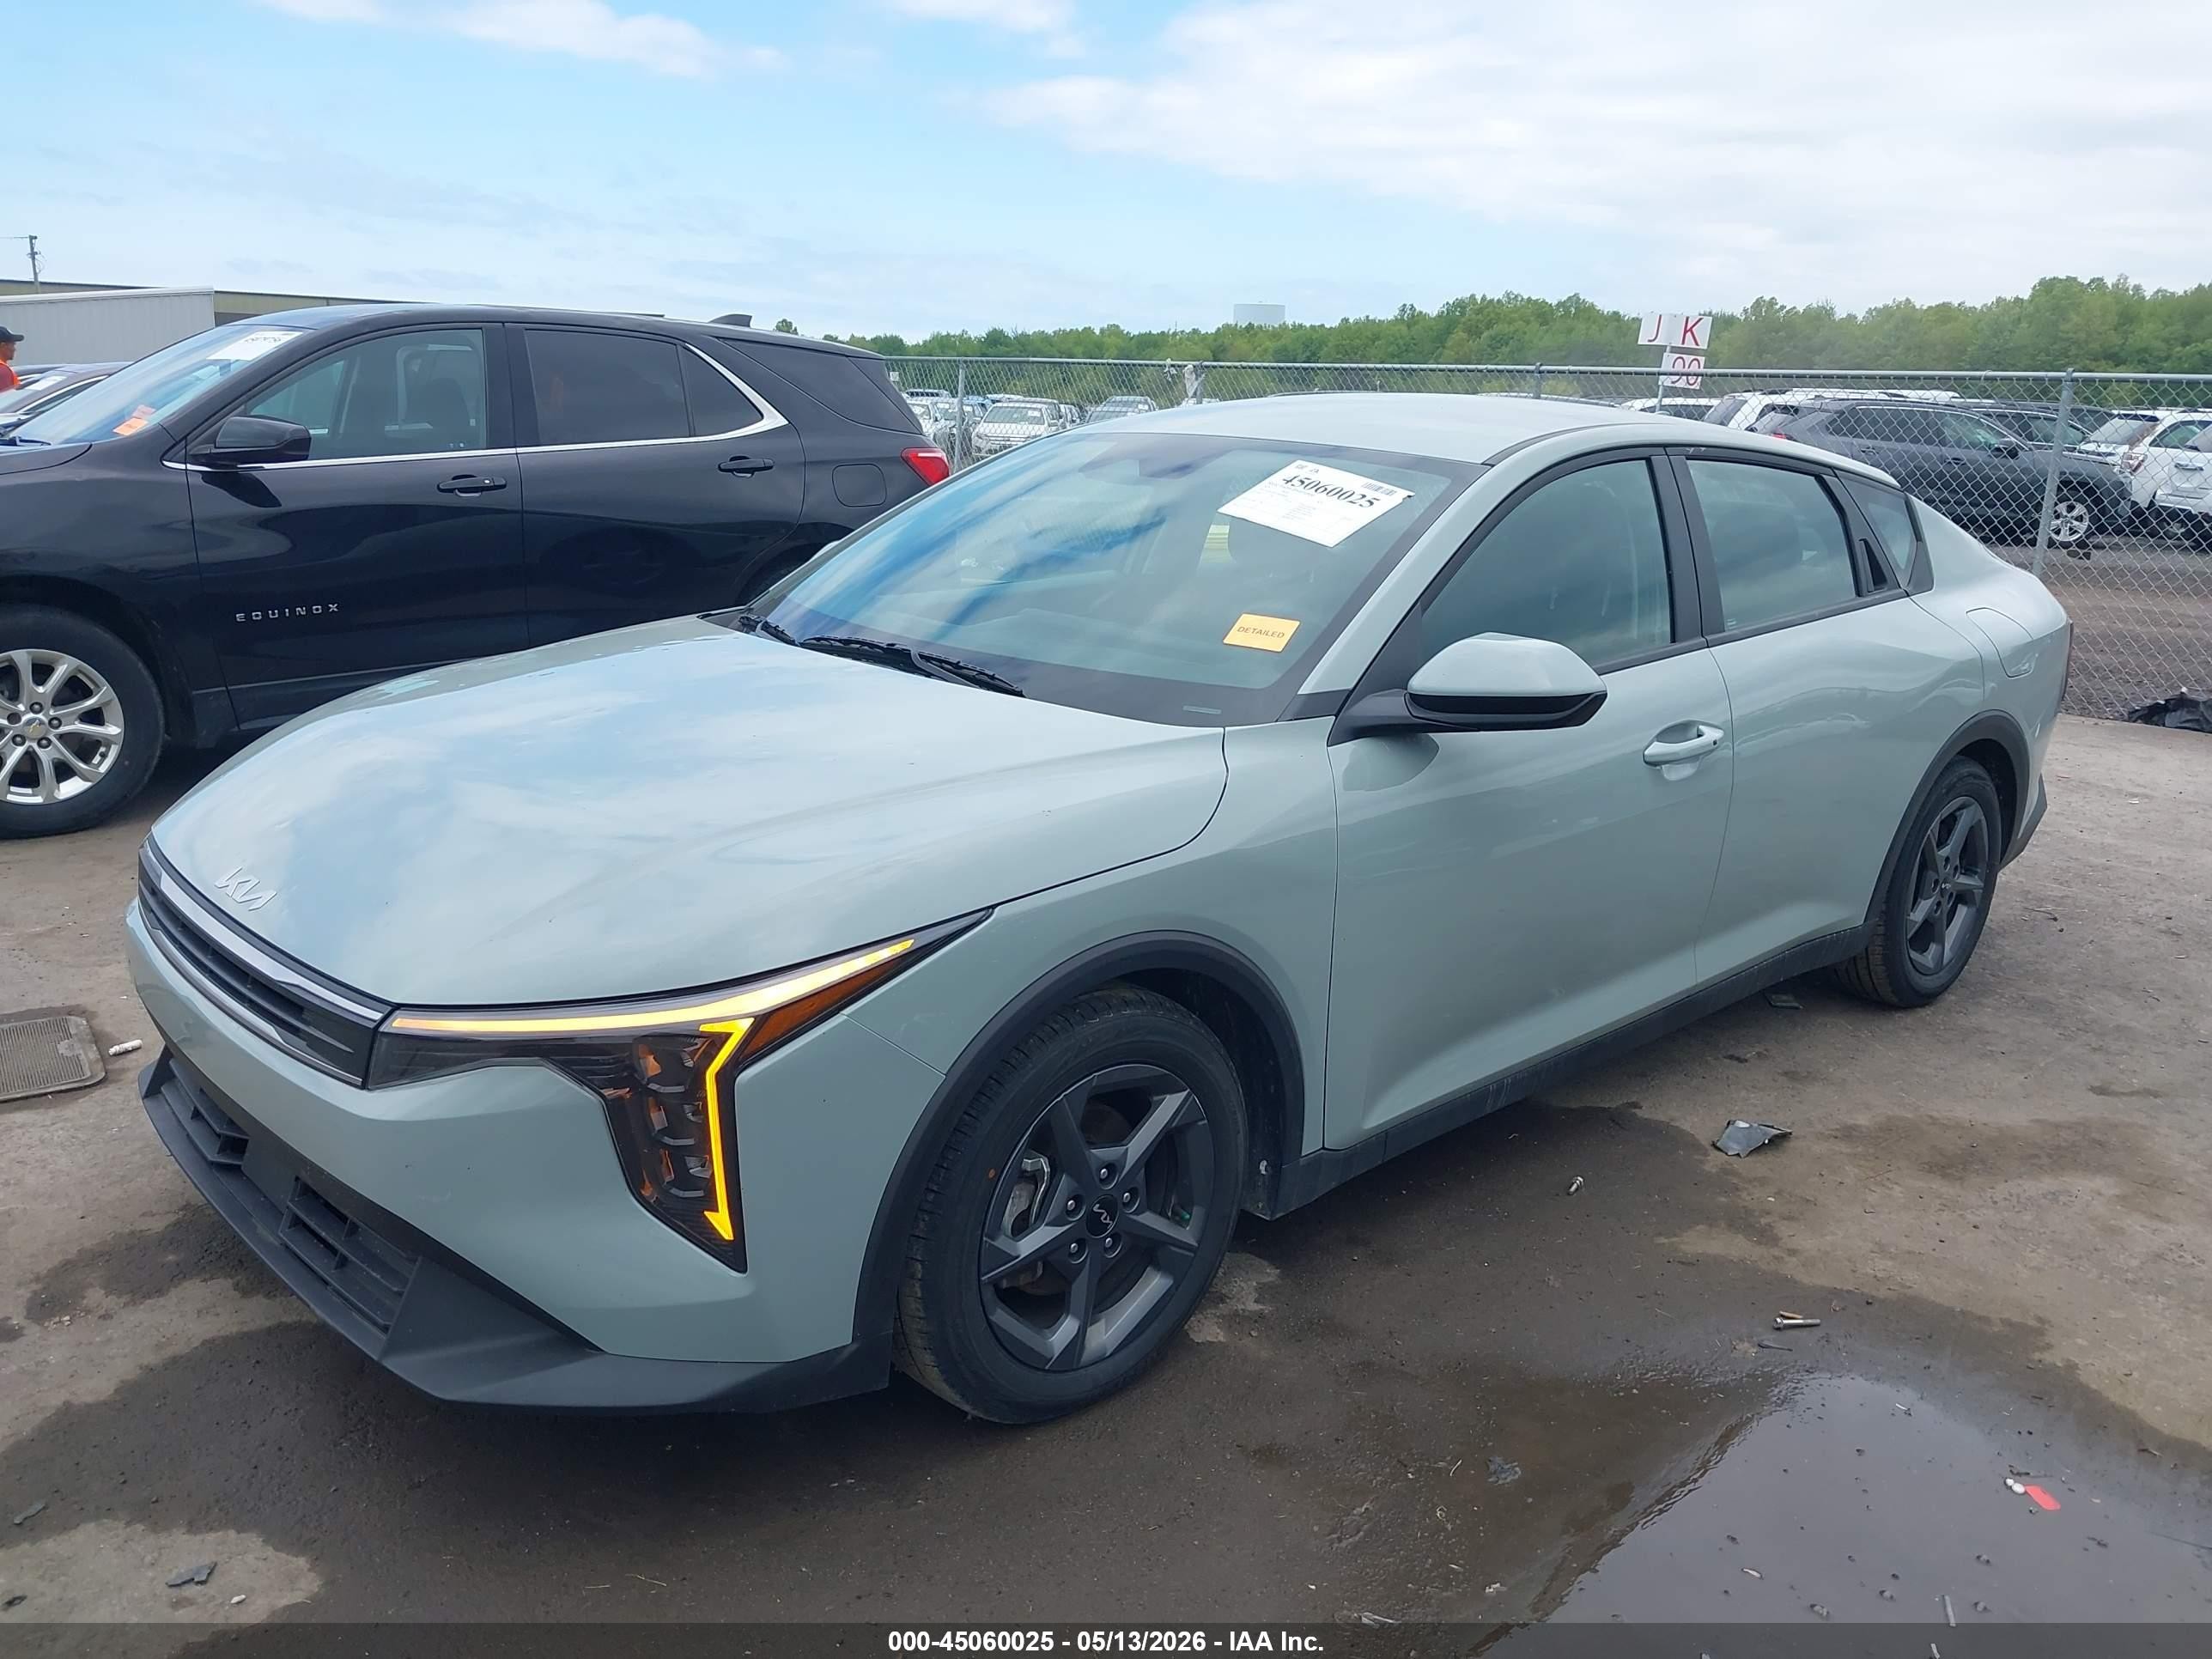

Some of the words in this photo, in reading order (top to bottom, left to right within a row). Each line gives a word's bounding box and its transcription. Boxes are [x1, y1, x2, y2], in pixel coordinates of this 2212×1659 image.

[1647, 314, 1662, 343] J
[1680, 316, 1705, 347] K
[1282, 474, 1381, 509] 45060025
[235, 603, 339, 623] EQUINOX
[1237, 625, 1285, 640] DETAILED
